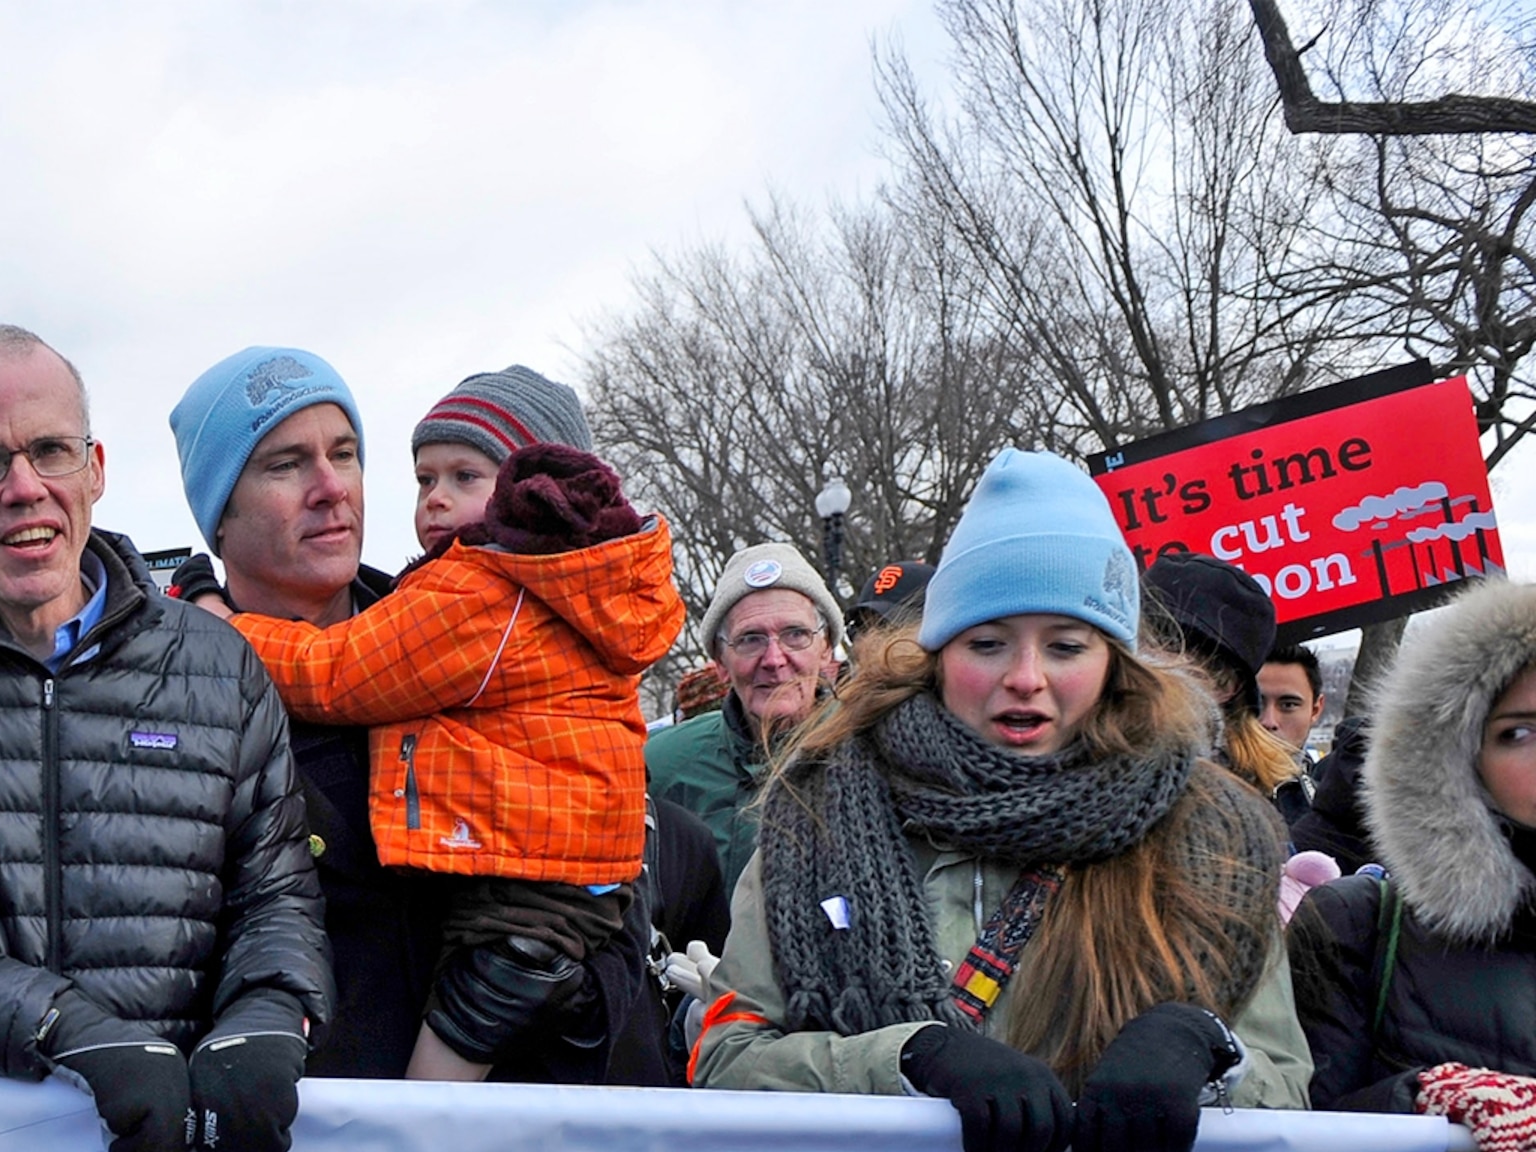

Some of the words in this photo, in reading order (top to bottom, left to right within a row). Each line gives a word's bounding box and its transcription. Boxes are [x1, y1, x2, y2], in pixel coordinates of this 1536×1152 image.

[1117, 471, 1211, 531] It's
[1227, 436, 1372, 500] time
[1210, 503, 1311, 561] cut
